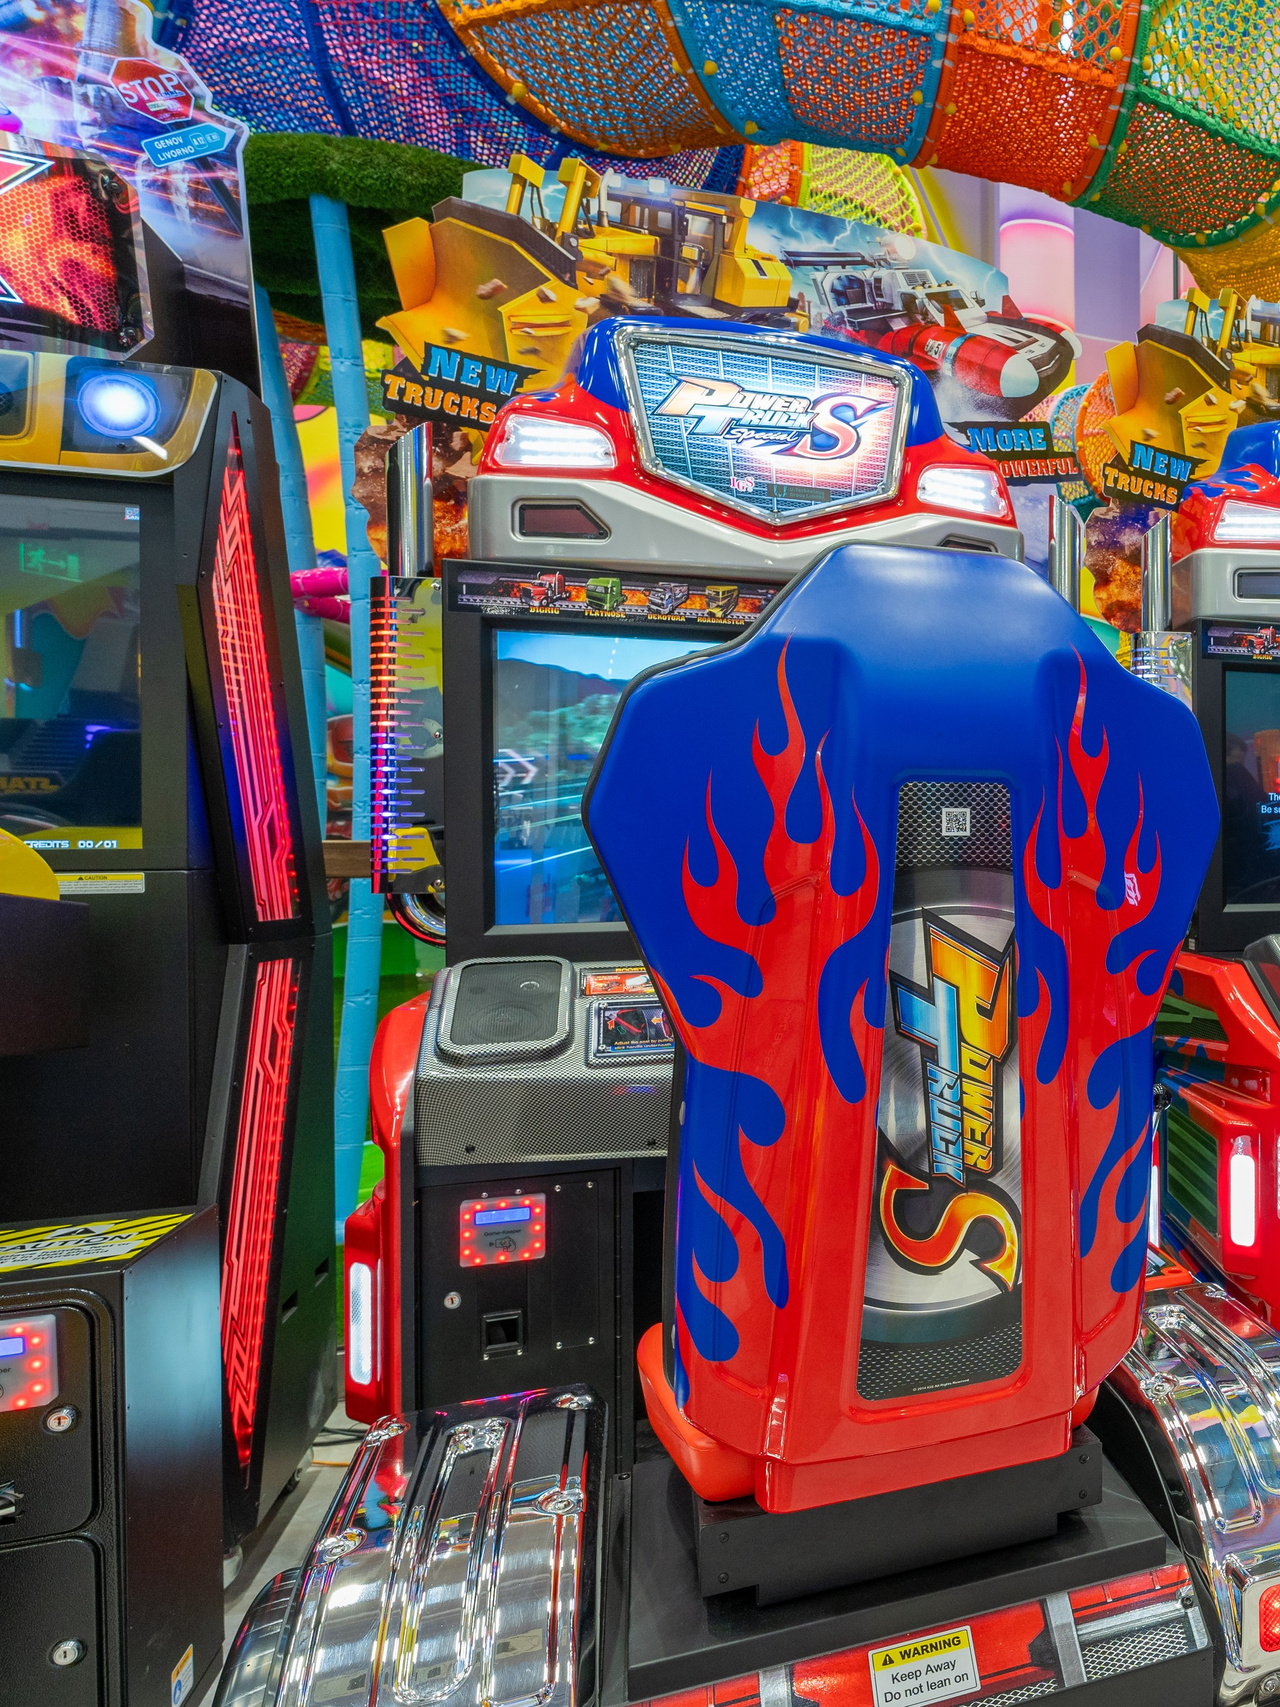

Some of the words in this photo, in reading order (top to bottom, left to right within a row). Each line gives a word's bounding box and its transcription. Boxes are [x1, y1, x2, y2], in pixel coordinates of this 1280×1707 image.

[118, 73, 179, 103] STOP
[157, 145, 195, 161] LIVORNO
[428, 346, 518, 396] NEW
[384, 373, 497, 424] TRUCKS
[656, 374, 812, 416] POWER
[688, 405, 818, 436] TRUCK
[723, 427, 799, 444] Special
[967, 427, 1047, 452] MORE
[1133, 443, 1192, 482] NEW
[730, 476, 755, 492] IGS
[1104, 467, 1178, 504] TRUCKS
[529, 606, 560, 615] BIGRIG
[584, 609, 627, 619] FLATNOSE
[647, 613, 686, 622] DEKOTORA
[697, 616, 745, 626] ROADMASTER
[1261, 805, 1272, 814] Be
[23, 840, 70, 849] CREDITS
[77, 840, 118, 849] 00/01
[928, 925, 1012, 1174] POWER
[896, 977, 967, 1187] TRUCK
[484, 1229, 522, 1237] Game-Keeper
[880, 1163, 1019, 1289] S
[899, 1636, 961, 1660] WARNING
[891, 1668, 922, 1685] Keep
[925, 1659, 957, 1676] Away
[884, 1691, 901, 1703] Do
[904, 1684, 924, 1697] not
[926, 1677, 951, 1692] lean
[954, 1672, 969, 1683] on
